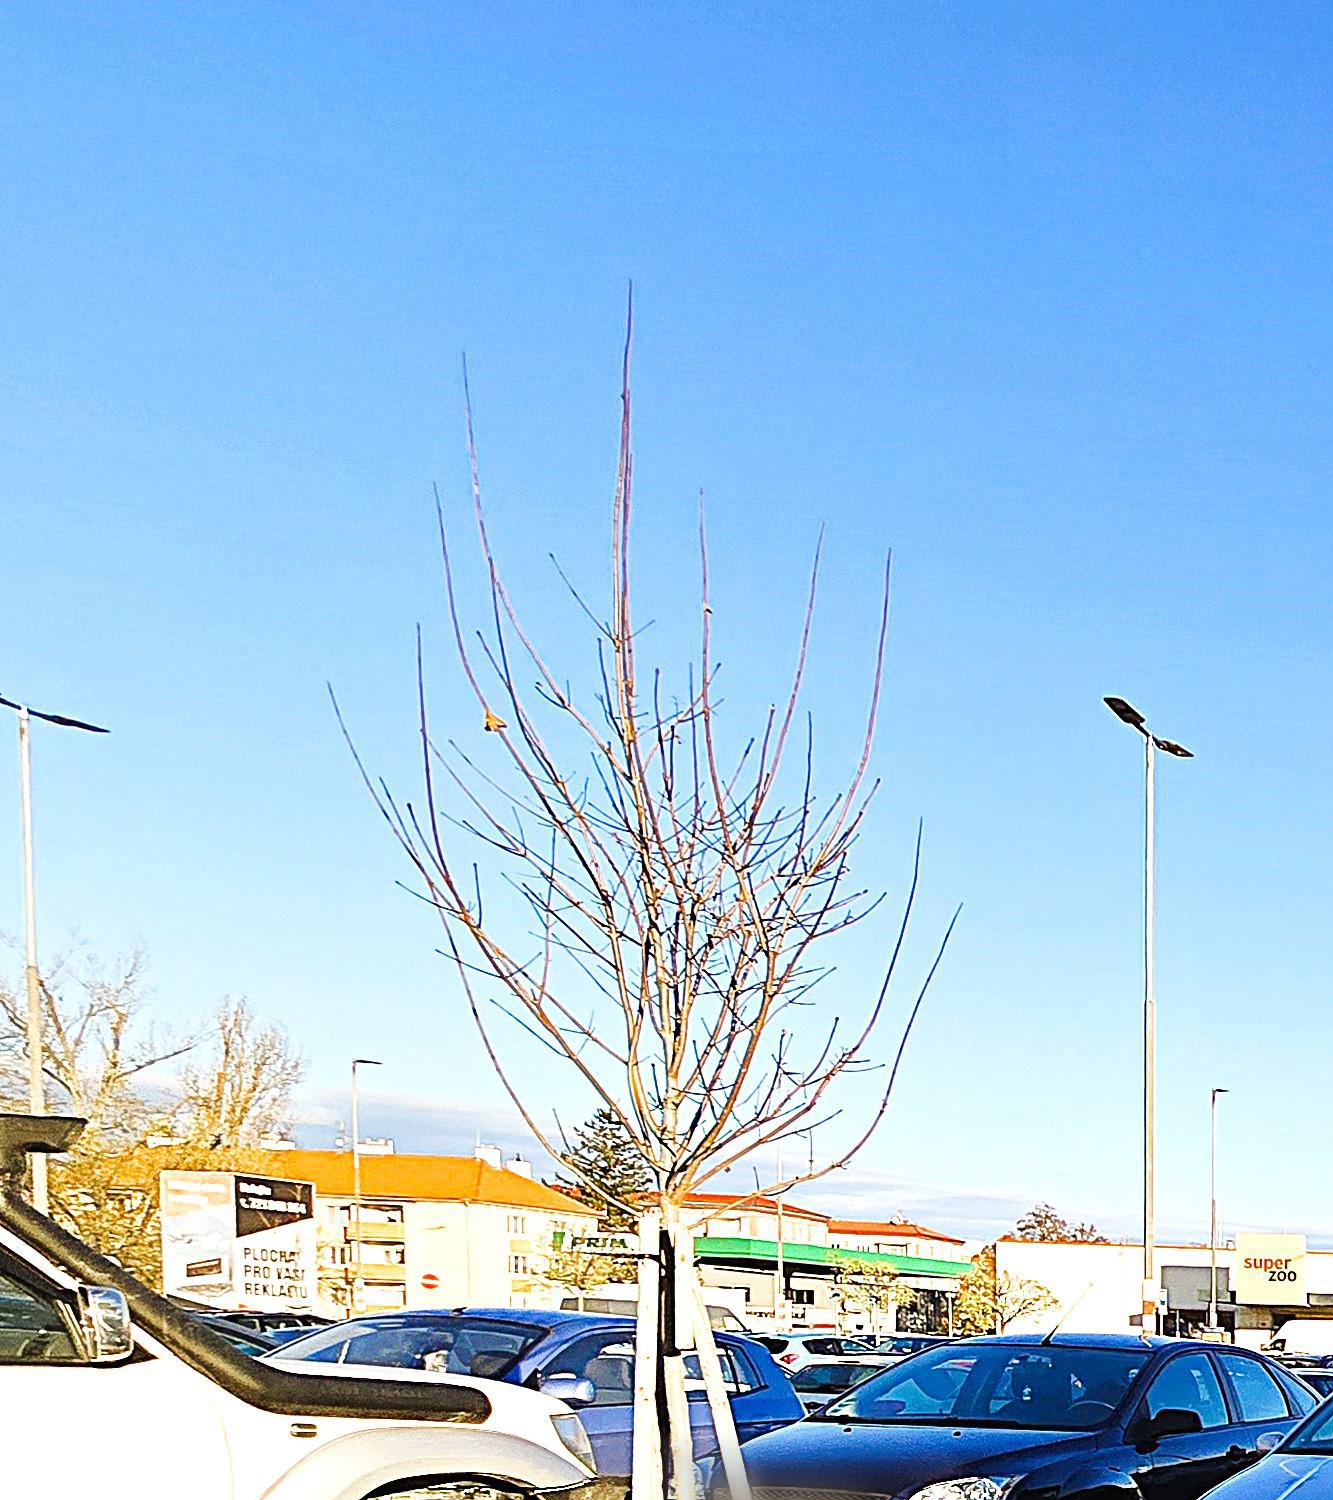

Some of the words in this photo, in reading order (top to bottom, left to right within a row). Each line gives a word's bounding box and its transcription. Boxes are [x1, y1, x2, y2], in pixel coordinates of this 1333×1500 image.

[244, 1265, 271, 1279] PRO
[1244, 1258, 1291, 1272] super
[1268, 1271, 1297, 1282] zoo
